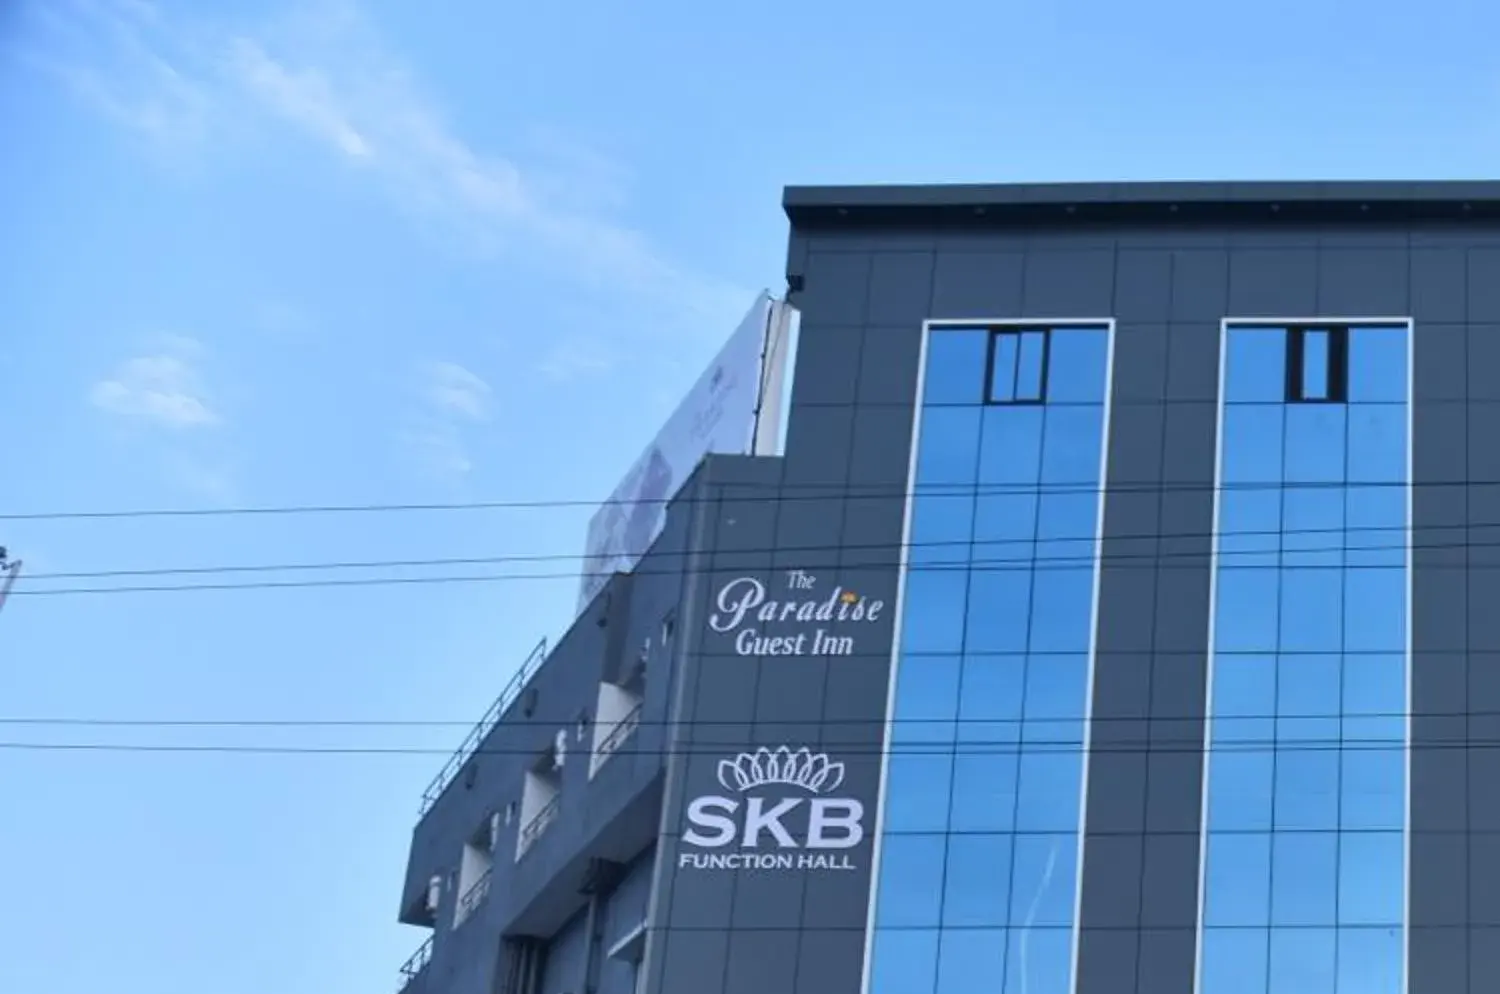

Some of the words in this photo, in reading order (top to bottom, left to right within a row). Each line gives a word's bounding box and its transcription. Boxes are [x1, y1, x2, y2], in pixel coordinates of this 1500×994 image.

[786, 569, 817, 589] The
[709, 576, 884, 632] Paradise
[735, 629, 807, 655] Guest
[812, 629, 854, 655] Inn
[681, 795, 865, 849] SKB
[679, 853, 793, 869] FUNCTION
[797, 854, 857, 870] HALL
